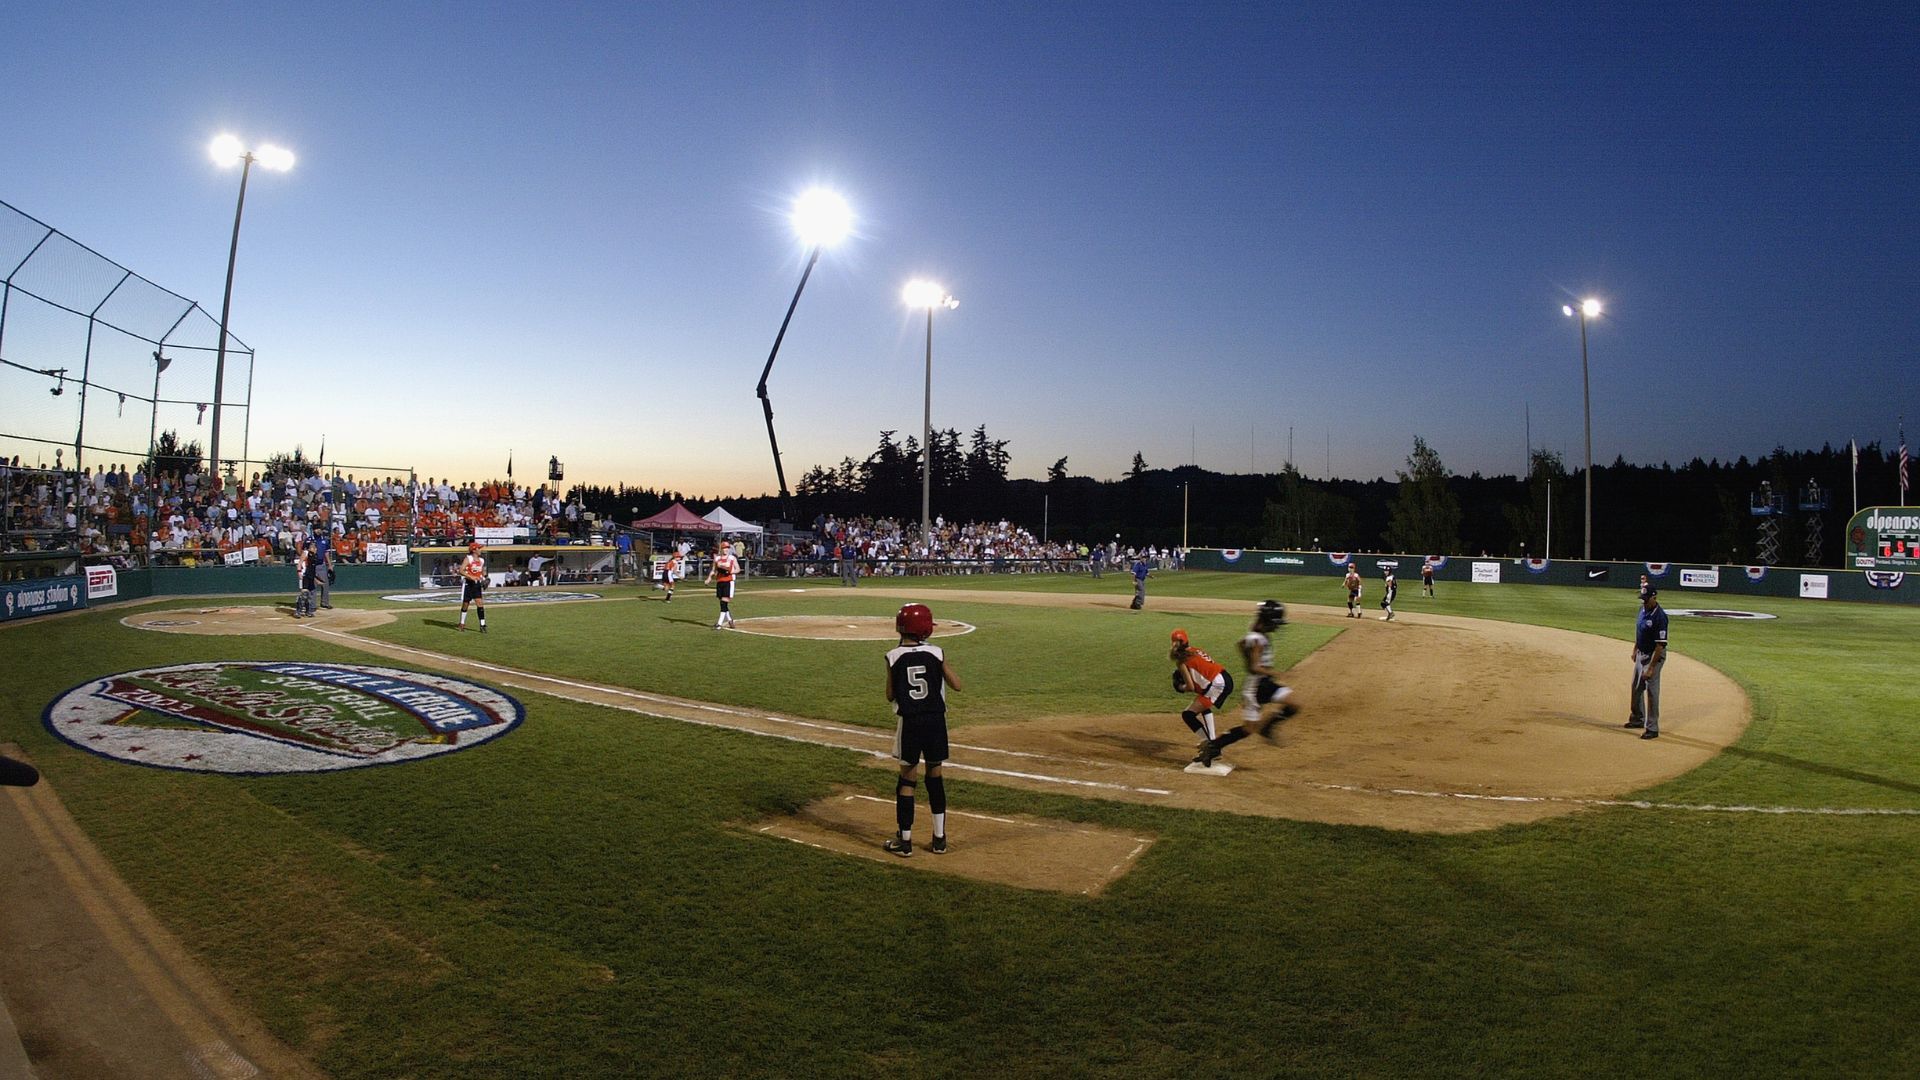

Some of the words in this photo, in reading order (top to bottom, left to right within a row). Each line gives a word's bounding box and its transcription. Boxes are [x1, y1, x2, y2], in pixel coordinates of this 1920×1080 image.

[1867, 508, 1920, 533] alpenros
[260, 676, 398, 721] SOFTBALL
[264, 666, 394, 688] LITTLE
[376, 686, 479, 729] LEAGUE
[907, 665, 929, 700] 5
[112, 688, 195, 713] 2003
